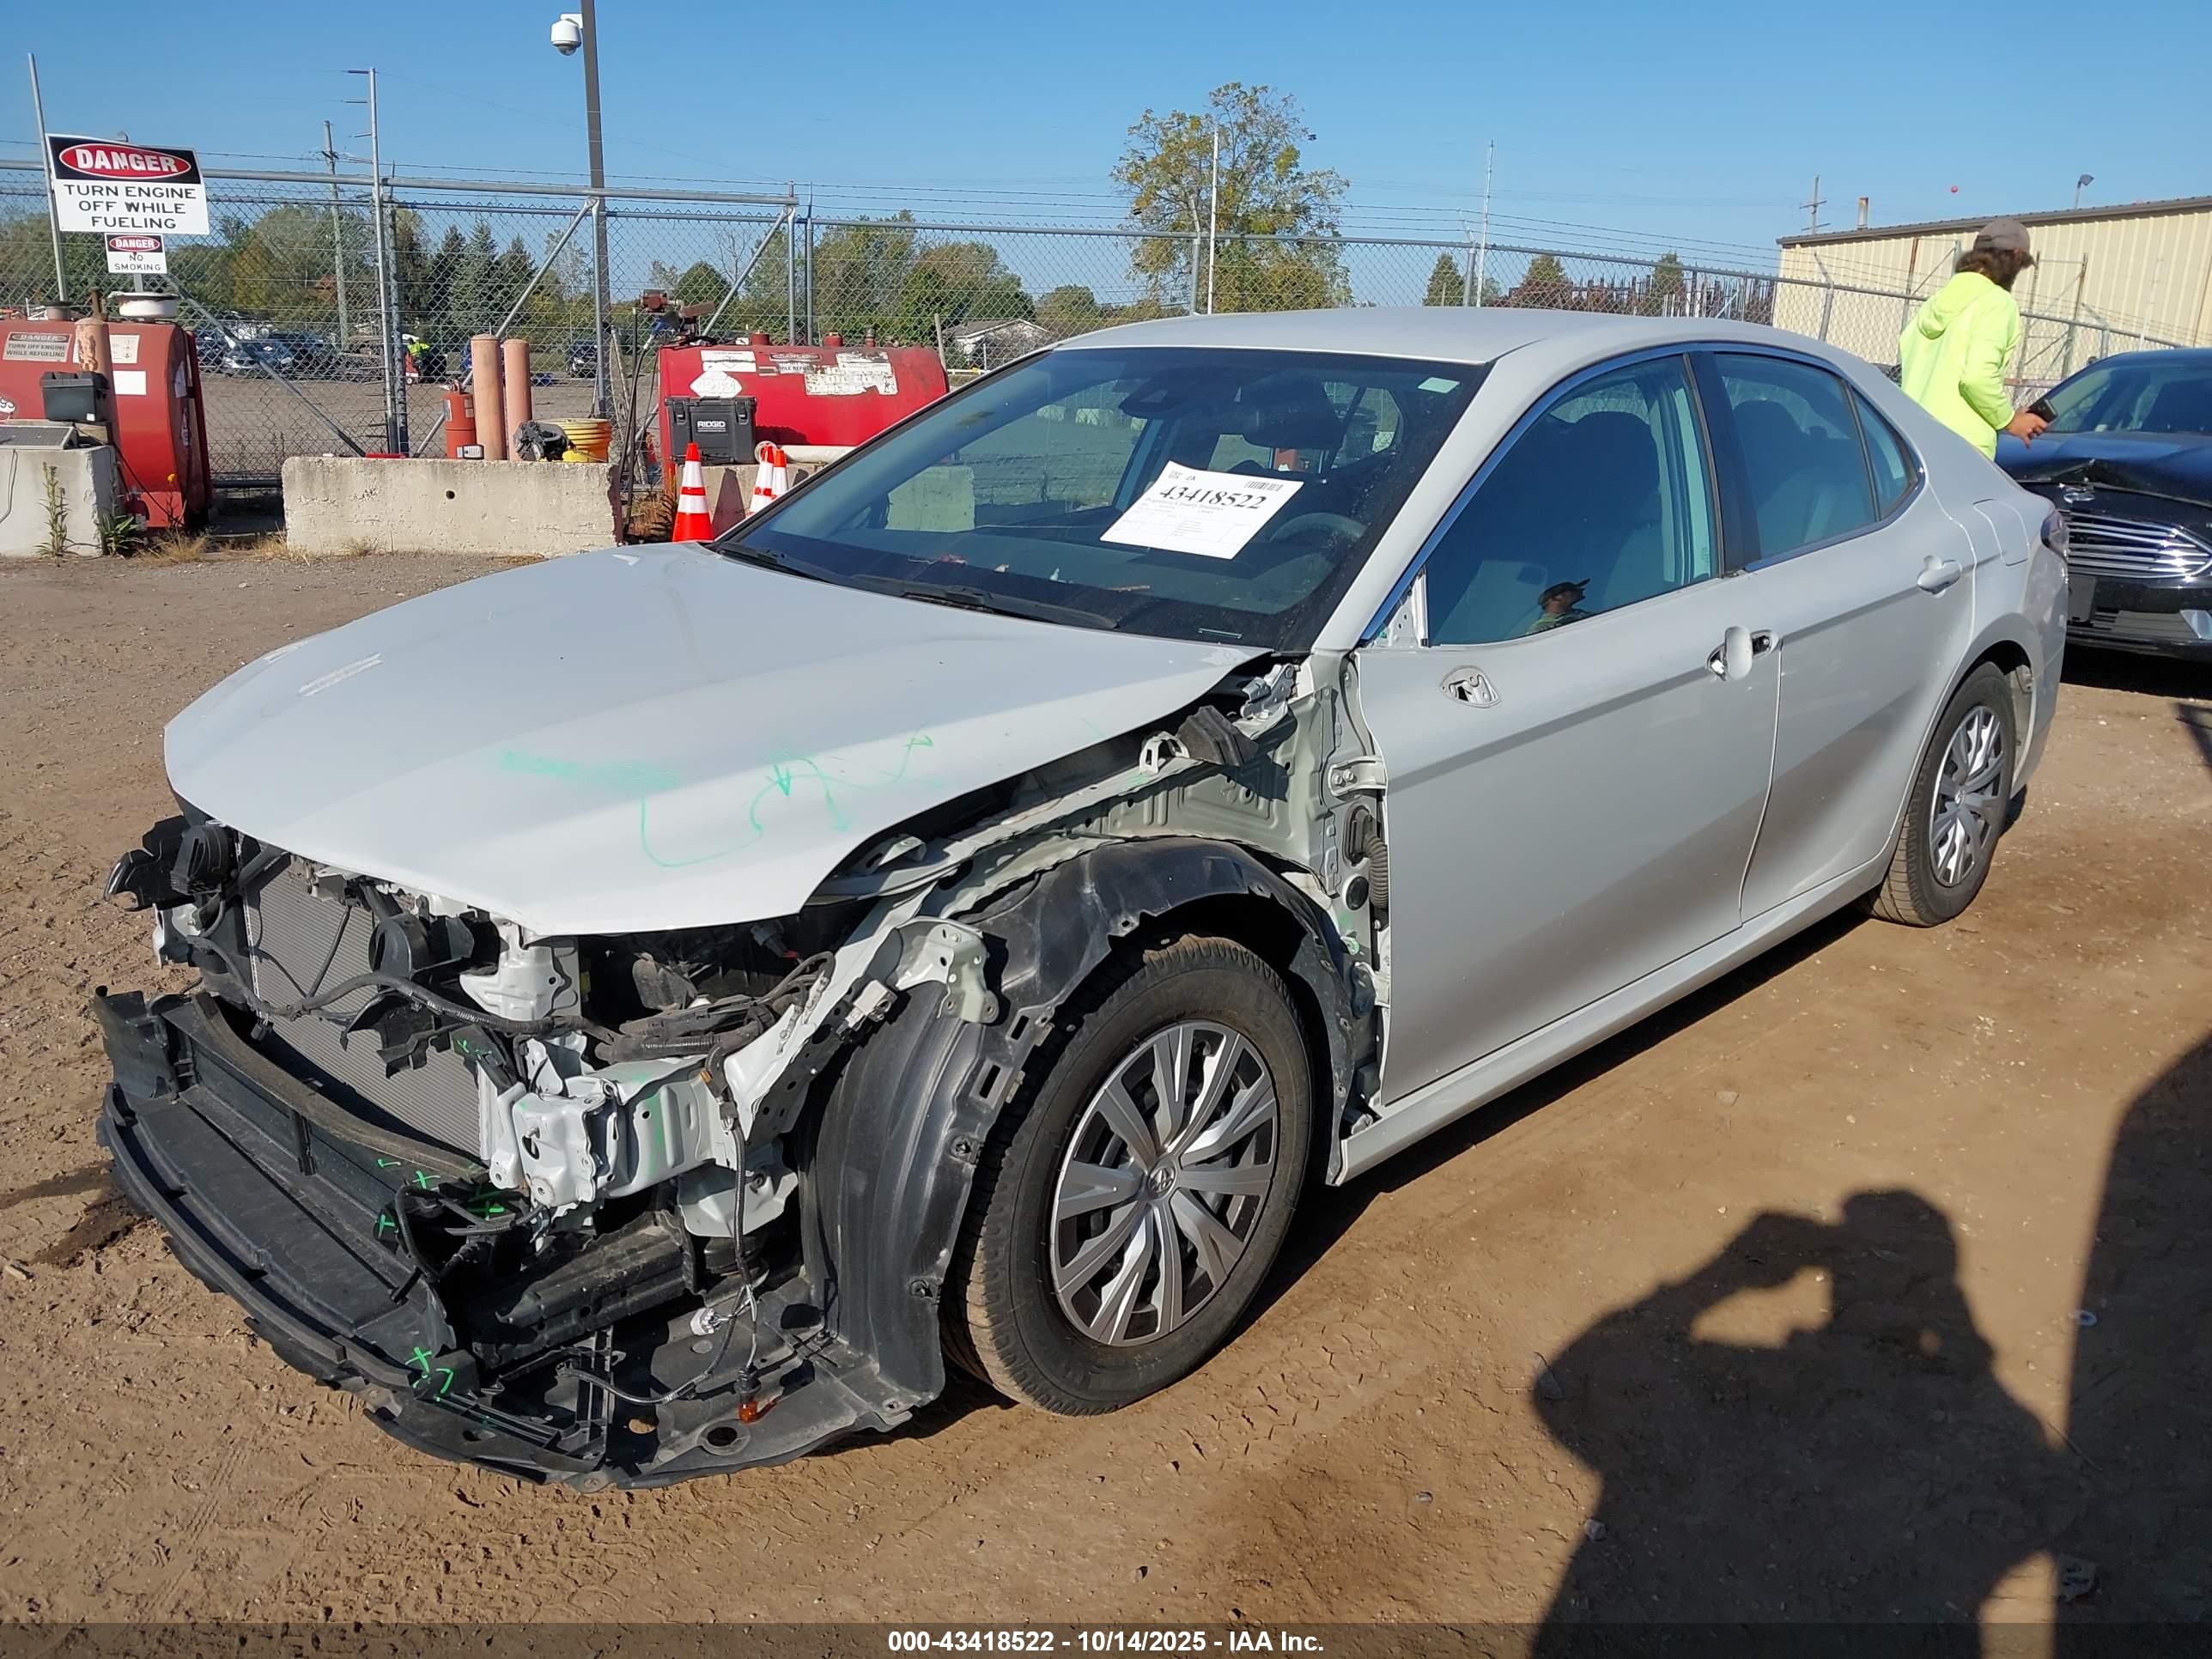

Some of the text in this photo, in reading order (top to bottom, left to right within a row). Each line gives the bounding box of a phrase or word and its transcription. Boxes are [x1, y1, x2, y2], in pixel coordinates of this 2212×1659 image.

[75, 149, 179, 173] DANGER
[64, 184, 197, 199] TURN ENGINE
[78, 200, 186, 215] OFF WHILE
[91, 216, 177, 229] FUELING
[115, 239, 155, 248] DANGER
[114, 263, 161, 271] SMOKING
[1159, 485, 1267, 510] 43418522
